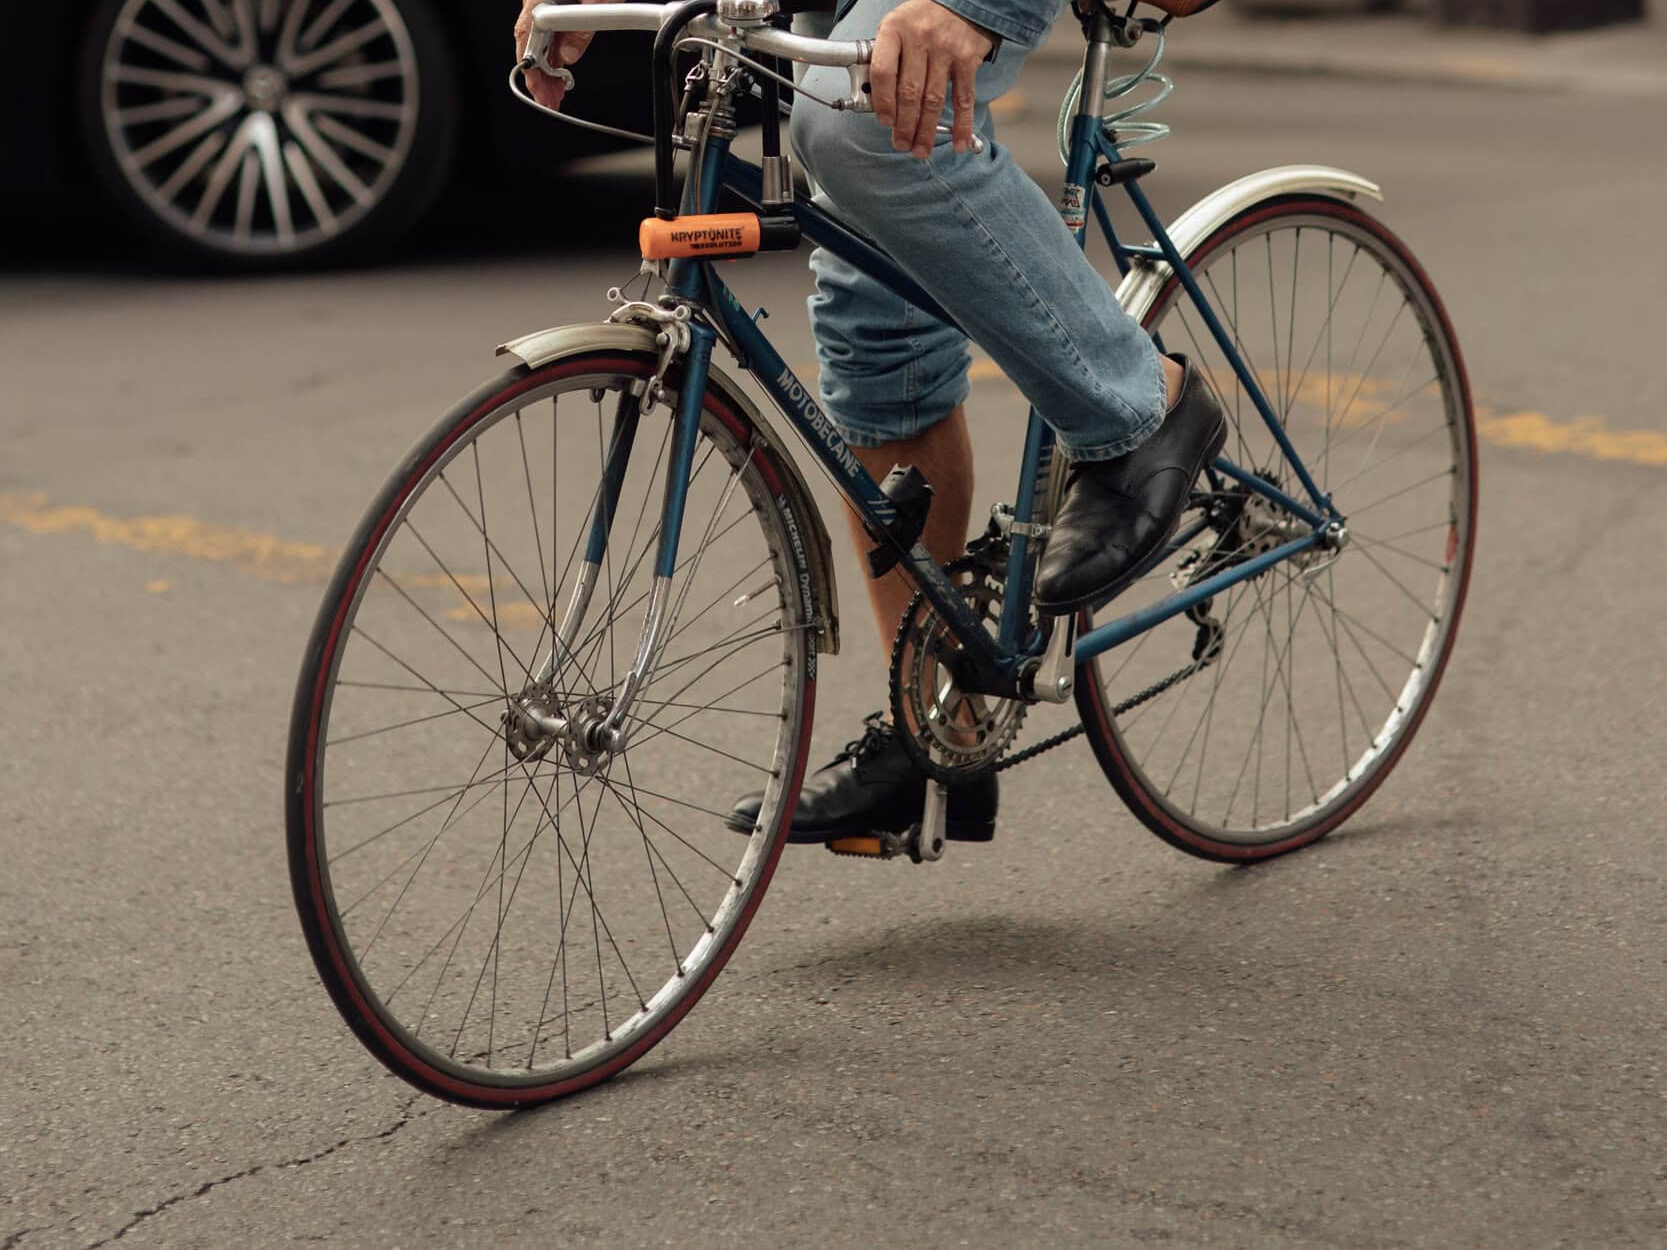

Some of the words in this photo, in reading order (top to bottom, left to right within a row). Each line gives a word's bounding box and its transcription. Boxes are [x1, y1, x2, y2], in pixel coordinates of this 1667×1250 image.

[671, 227, 743, 243] KRYPTONITE
[777, 368, 860, 478] MOTOBECANE
[783, 507, 807, 569] MICHELIN
